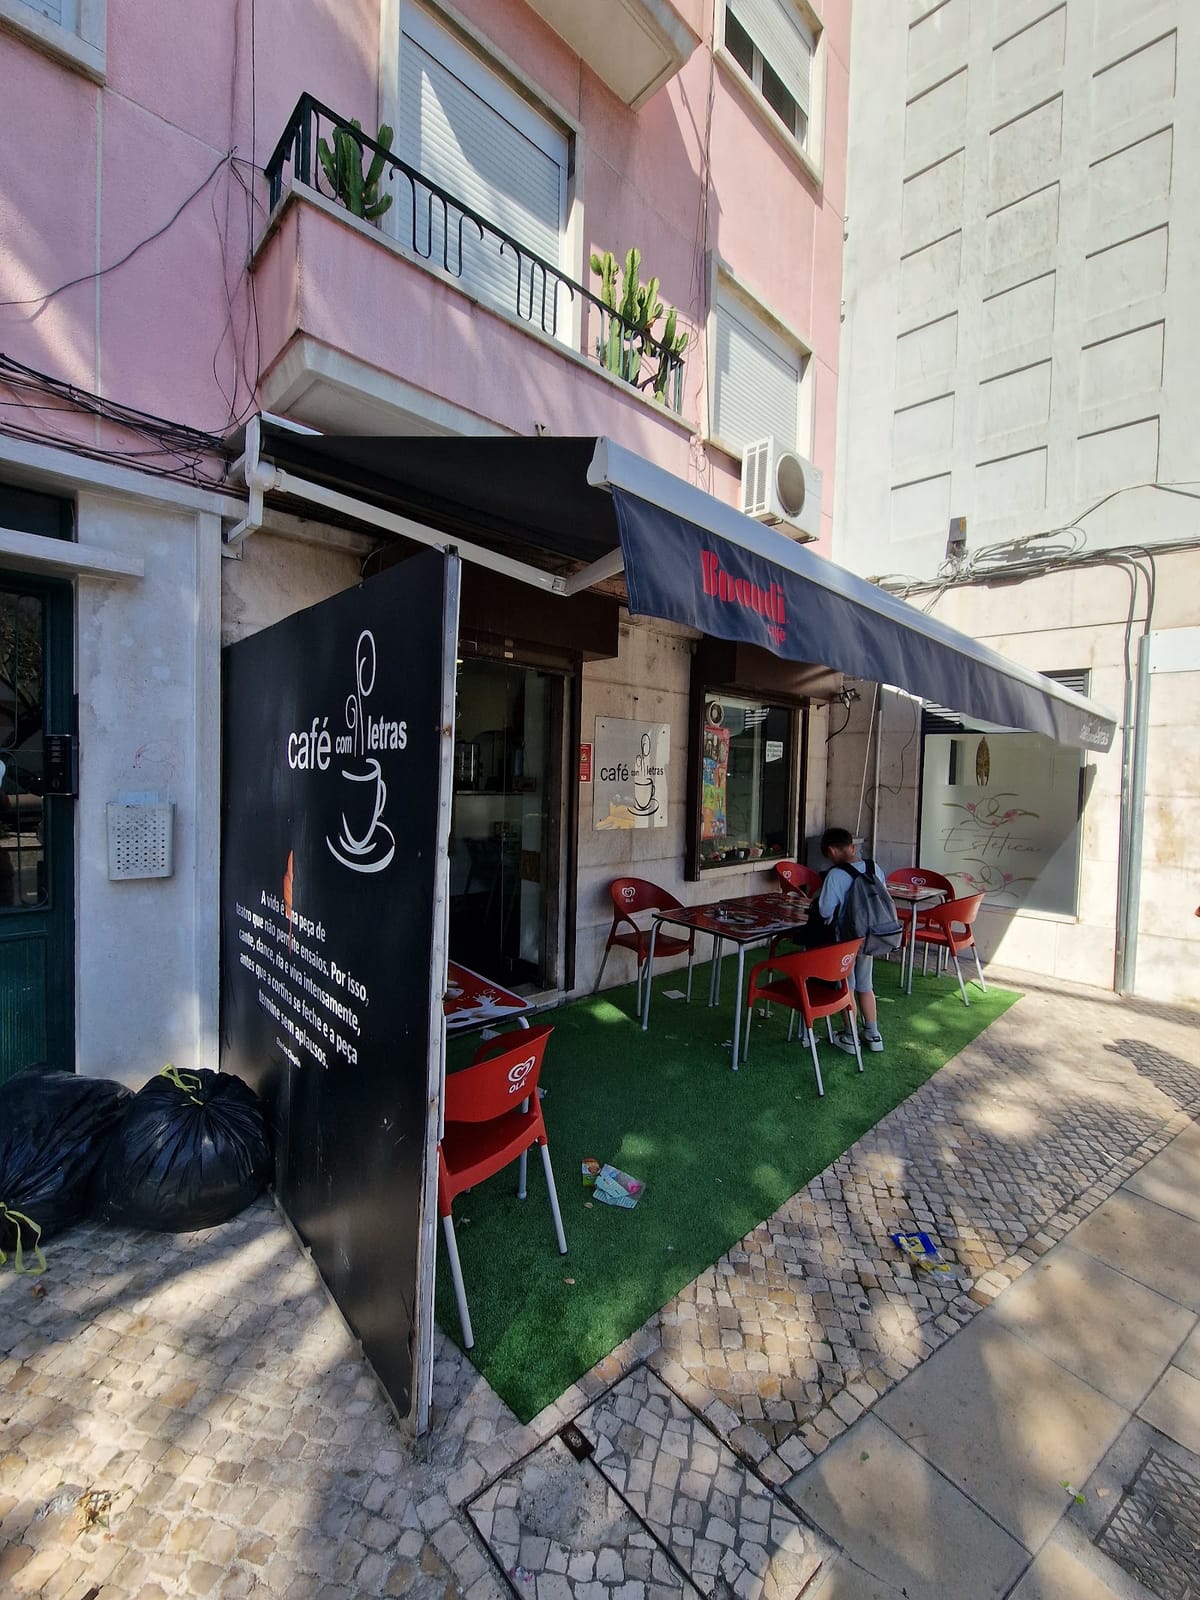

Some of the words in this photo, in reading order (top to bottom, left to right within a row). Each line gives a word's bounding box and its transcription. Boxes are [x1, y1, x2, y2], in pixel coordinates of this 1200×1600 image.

[700, 549, 785, 624] Buondi
[288, 717, 331, 770] café
[336, 736, 353, 754] com
[368, 714, 408, 750] letras
[600, 763, 629, 781] café
[646, 765, 664, 776] letras
[236, 901, 252, 922] teatro
[252, 913, 264, 929] que
[265, 918, 276, 937] não
[301, 945, 329, 976] ensaios.
[331, 961, 347, 987] Por
[347, 970, 369, 1008] isso,
[261, 890, 267, 906] A
[266, 893, 280, 913] vida
[280, 899, 285, 916] é
[299, 915, 315, 938] peça
[316, 920, 326, 943] de
[239, 929, 256, 951] cante,
[256, 936, 275, 966] dance,
[276, 951, 284, 970] ria
[284, 961, 289, 974] e
[290, 963, 303, 986] viva
[303, 971, 361, 1037] intensamente,
[240, 952, 255, 972] antes
[255, 964, 267, 981] que
[267, 973, 272, 986] a
[271, 977, 293, 1006] cortina
[293, 996, 301, 1013] se
[302, 999, 322, 1032] feche
[323, 1022, 329, 1038] e
[329, 1028, 335, 1045] a
[336, 1033, 358, 1065] peça
[258, 988, 281, 1021] termine
[281, 1013, 295, 1036] sem
[295, 1026, 329, 1069] aplausos.
